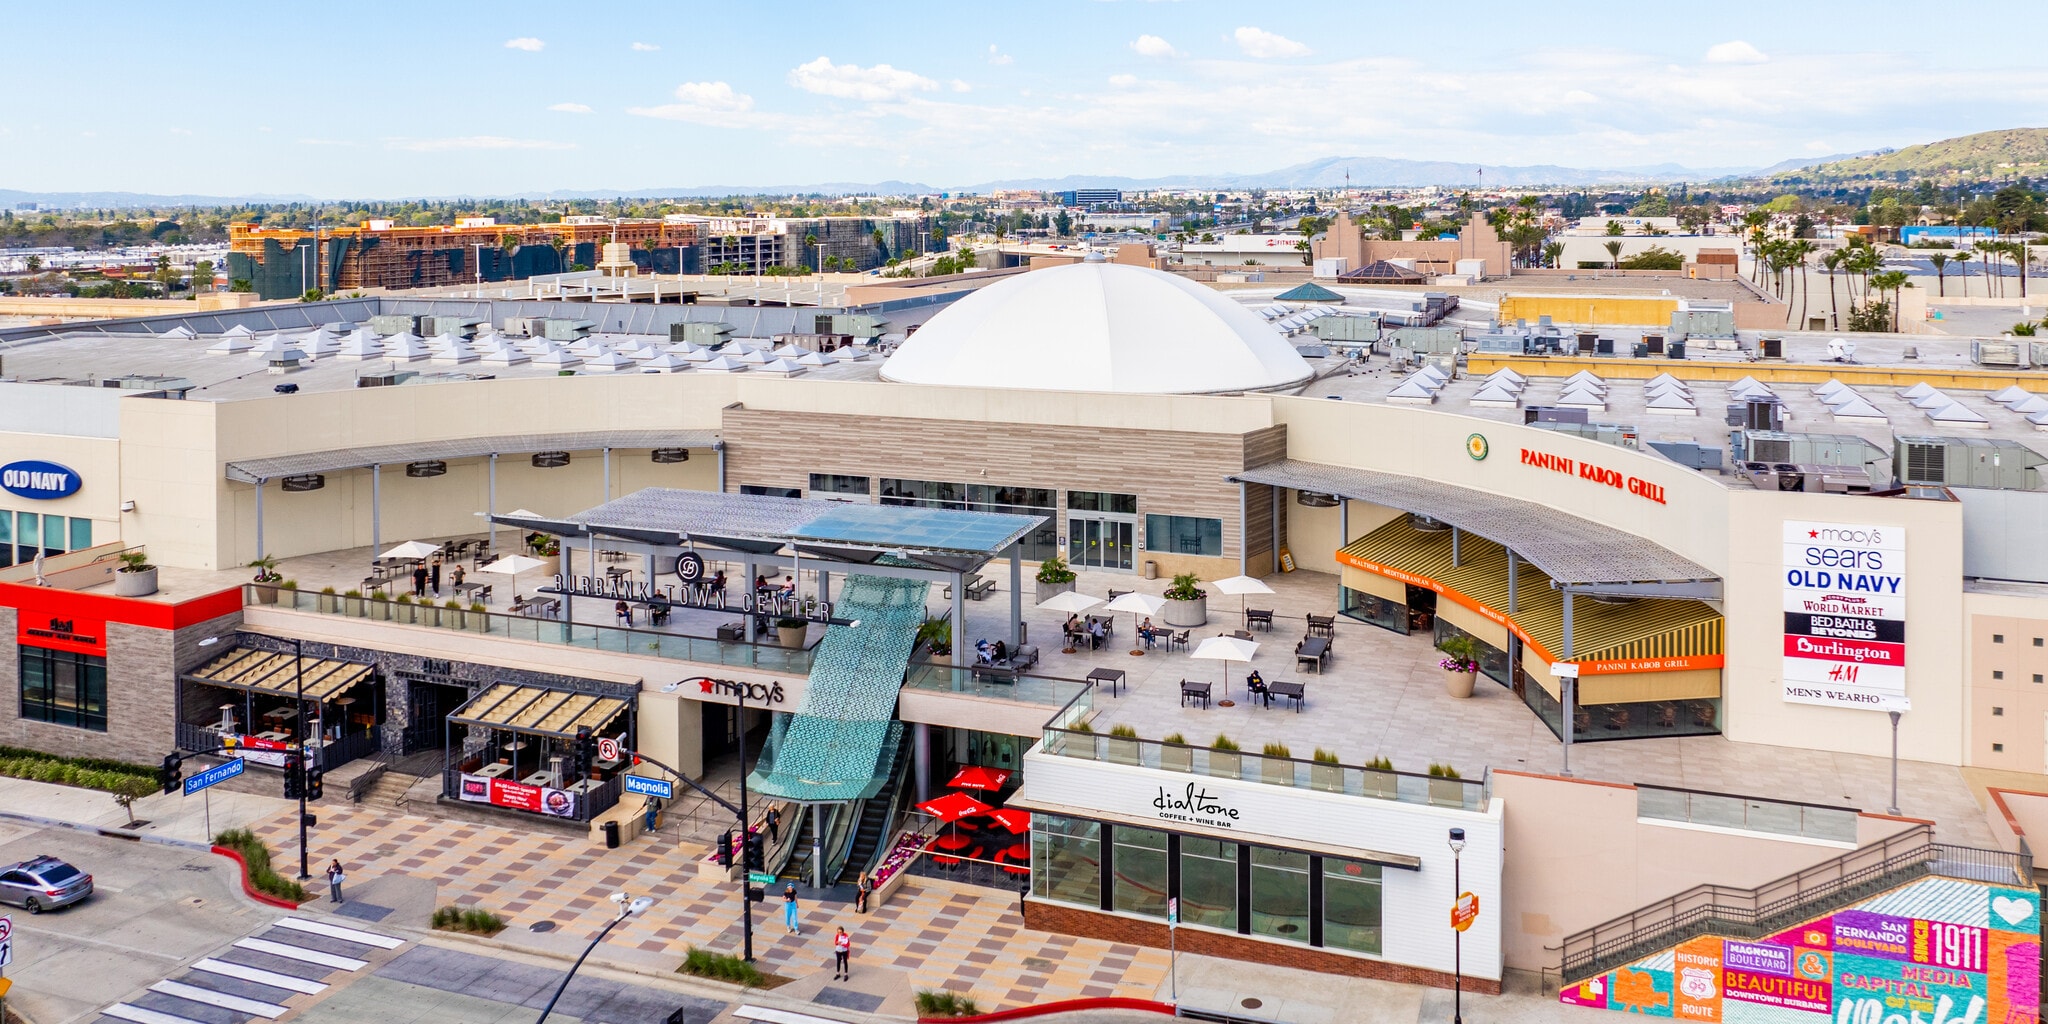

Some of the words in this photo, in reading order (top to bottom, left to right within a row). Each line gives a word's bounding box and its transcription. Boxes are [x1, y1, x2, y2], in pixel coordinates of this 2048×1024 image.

[3, 469, 30, 489] OLD
[30, 471, 68, 492] NAVY
[1520, 448, 1574, 475] PANINI
[1579, 461, 1624, 489] KABOB
[1627, 476, 1667, 505] GRILL
[1821, 528, 1882, 546] macy's
[1805, 547, 1883, 570] sears
[1350, 557, 1379, 572] HEALTHIER
[1383, 567, 1429, 587] MEDITERRANEAN
[1787, 569, 1832, 589] OLD
[1837, 572, 1902, 594] NAVY
[554, 574, 649, 602] BURBANK
[663, 584, 726, 610] TOWN
[741, 593, 832, 622] CENTER
[1803, 600, 1839, 613] WORLD
[1841, 603, 1884, 617] MARKET
[1811, 615, 1833, 628] BED
[1835, 618, 1865, 631] BATH
[1865, 620, 1877, 632] &
[1811, 627, 1877, 639] BEYOND
[1797, 637, 1891, 661] Burlington
[1597, 663, 1627, 671] PANINI
[1664, 660, 1689, 668] GRILL
[1828, 664, 1859, 683] H&M
[715, 680, 785, 706] macy's
[1786, 687, 1822, 698] MEN'S
[1826, 690, 1880, 704] WEARHO
[187, 778, 203, 791] San
[205, 762, 241, 780] Fernando
[627, 778, 669, 795] Magnolia
[1153, 782, 1240, 820] dialtone
[1159, 812, 1187, 822] COFFEE
[1196, 817, 1214, 826] WINE
[1216, 820, 1231, 828] BAR
[750, 873, 769, 882] Magnolia
[1835, 925, 1907, 944] FERNANDO
[1881, 921, 1907, 934] SAN
[1835, 936, 1907, 954] BOULEVARD
[1913, 920, 1929, 963] SINCE
[1931, 922, 1982, 970] 1911
[1677, 952, 1719, 967] HISTORIC
[1730, 944, 1785, 960] MAGNOLIA
[1729, 953, 1787, 971] BOULEVARD
[1802, 954, 1824, 976] &
[1726, 971, 1828, 1002] BEAUTIFUL
[1840, 972, 1934, 1000] CAPITAL
[1901, 965, 1972, 989] MEDIA
[1726, 989, 1782, 1004] DOWNTOWN
[1783, 998, 1827, 1011] BURBANK
[1885, 996, 1906, 1009] OF
[1909, 999, 1934, 1014] THE
[1682, 1003, 1713, 1018] ROUTE
